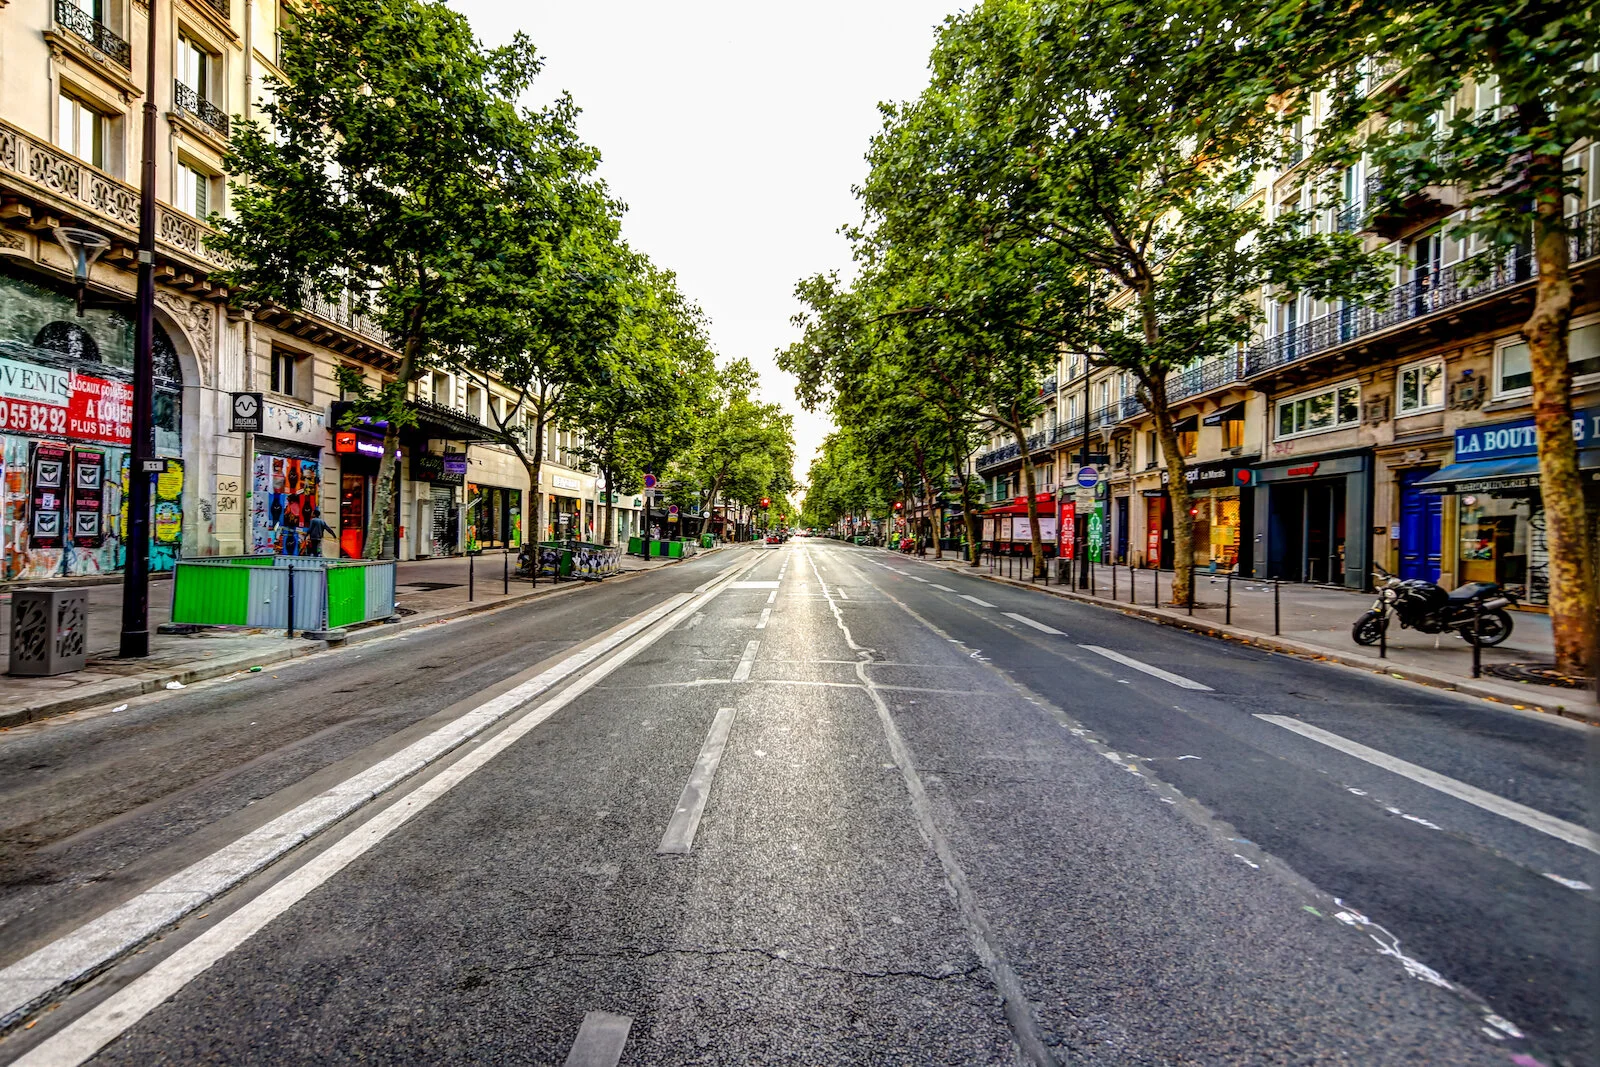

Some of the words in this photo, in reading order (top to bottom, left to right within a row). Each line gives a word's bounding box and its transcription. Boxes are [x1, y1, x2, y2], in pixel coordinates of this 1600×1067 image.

[0, 365, 69, 398] VENIS
[73, 379, 100, 395] LOCAUX
[10, 403, 27, 429] 55
[30, 405, 48, 431] 82
[50, 407, 66, 433] 92
[86, 399, 95, 418] A
[71, 419, 97, 434] PLUS
[99, 423, 112, 436] DE
[1457, 434, 1481, 454] LA
